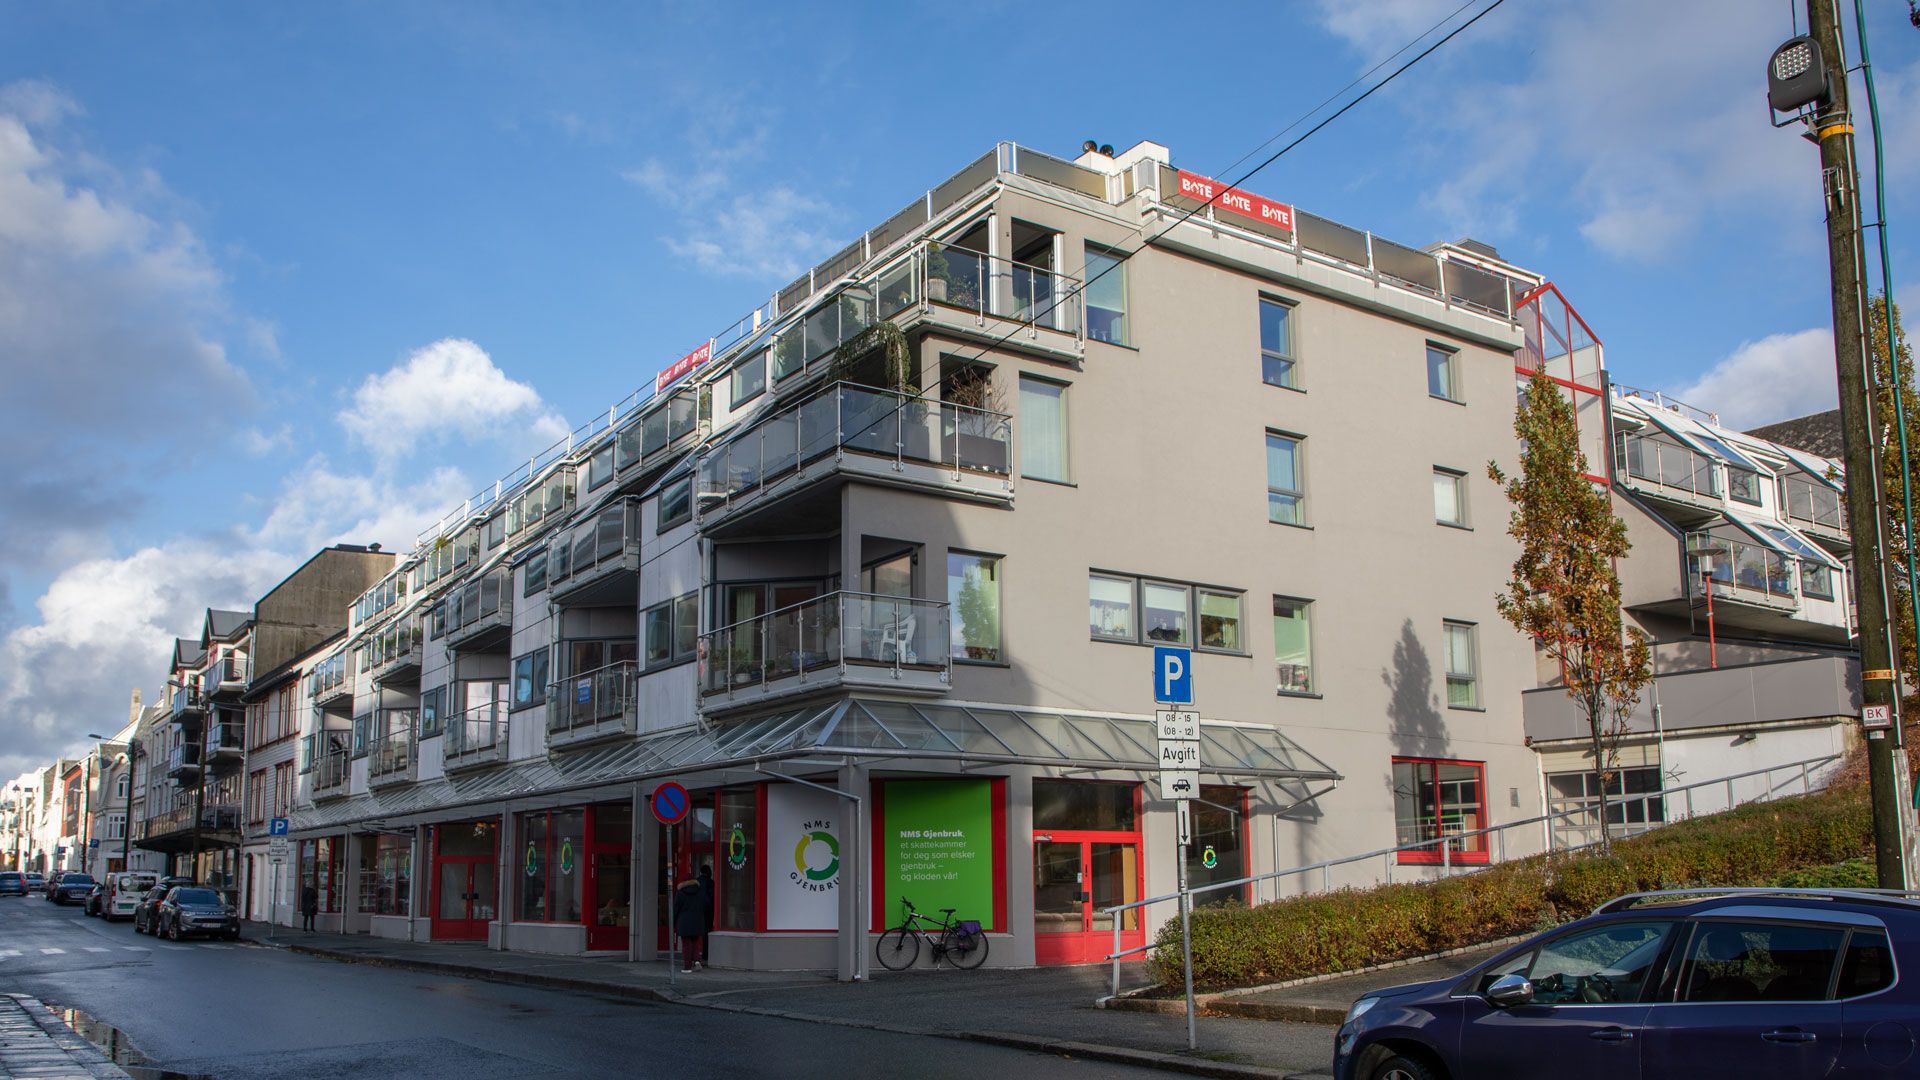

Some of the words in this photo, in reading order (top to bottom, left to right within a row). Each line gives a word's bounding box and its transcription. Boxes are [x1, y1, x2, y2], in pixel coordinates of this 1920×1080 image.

[1182, 178, 1212, 198] BATE
[1222, 193, 1251, 212] BATE
[1262, 204, 1289, 225] BATE
[1165, 655, 1183, 696] P
[1166, 714, 1176, 722] 08
[1184, 714, 1191, 722] 15
[1867, 709, 1883, 718] BK
[1164, 726, 1176, 736] (08
[1185, 727, 1194, 736] 12)
[1163, 747, 1196, 763] Avgift
[275, 821, 285, 834] P
[803, 820, 831, 830] NMS
[900, 830, 921, 838] NMS
[911, 841, 967, 849] skattekammer
[914, 852, 929, 860] deg
[950, 851, 976, 859] elsker
[900, 863, 936, 872] gjenbruk
[790, 872, 840, 892] GJENBRU
[900, 874, 912, 882] og
[914, 873, 941, 881] kloden
[943, 872, 959, 880] vår!
